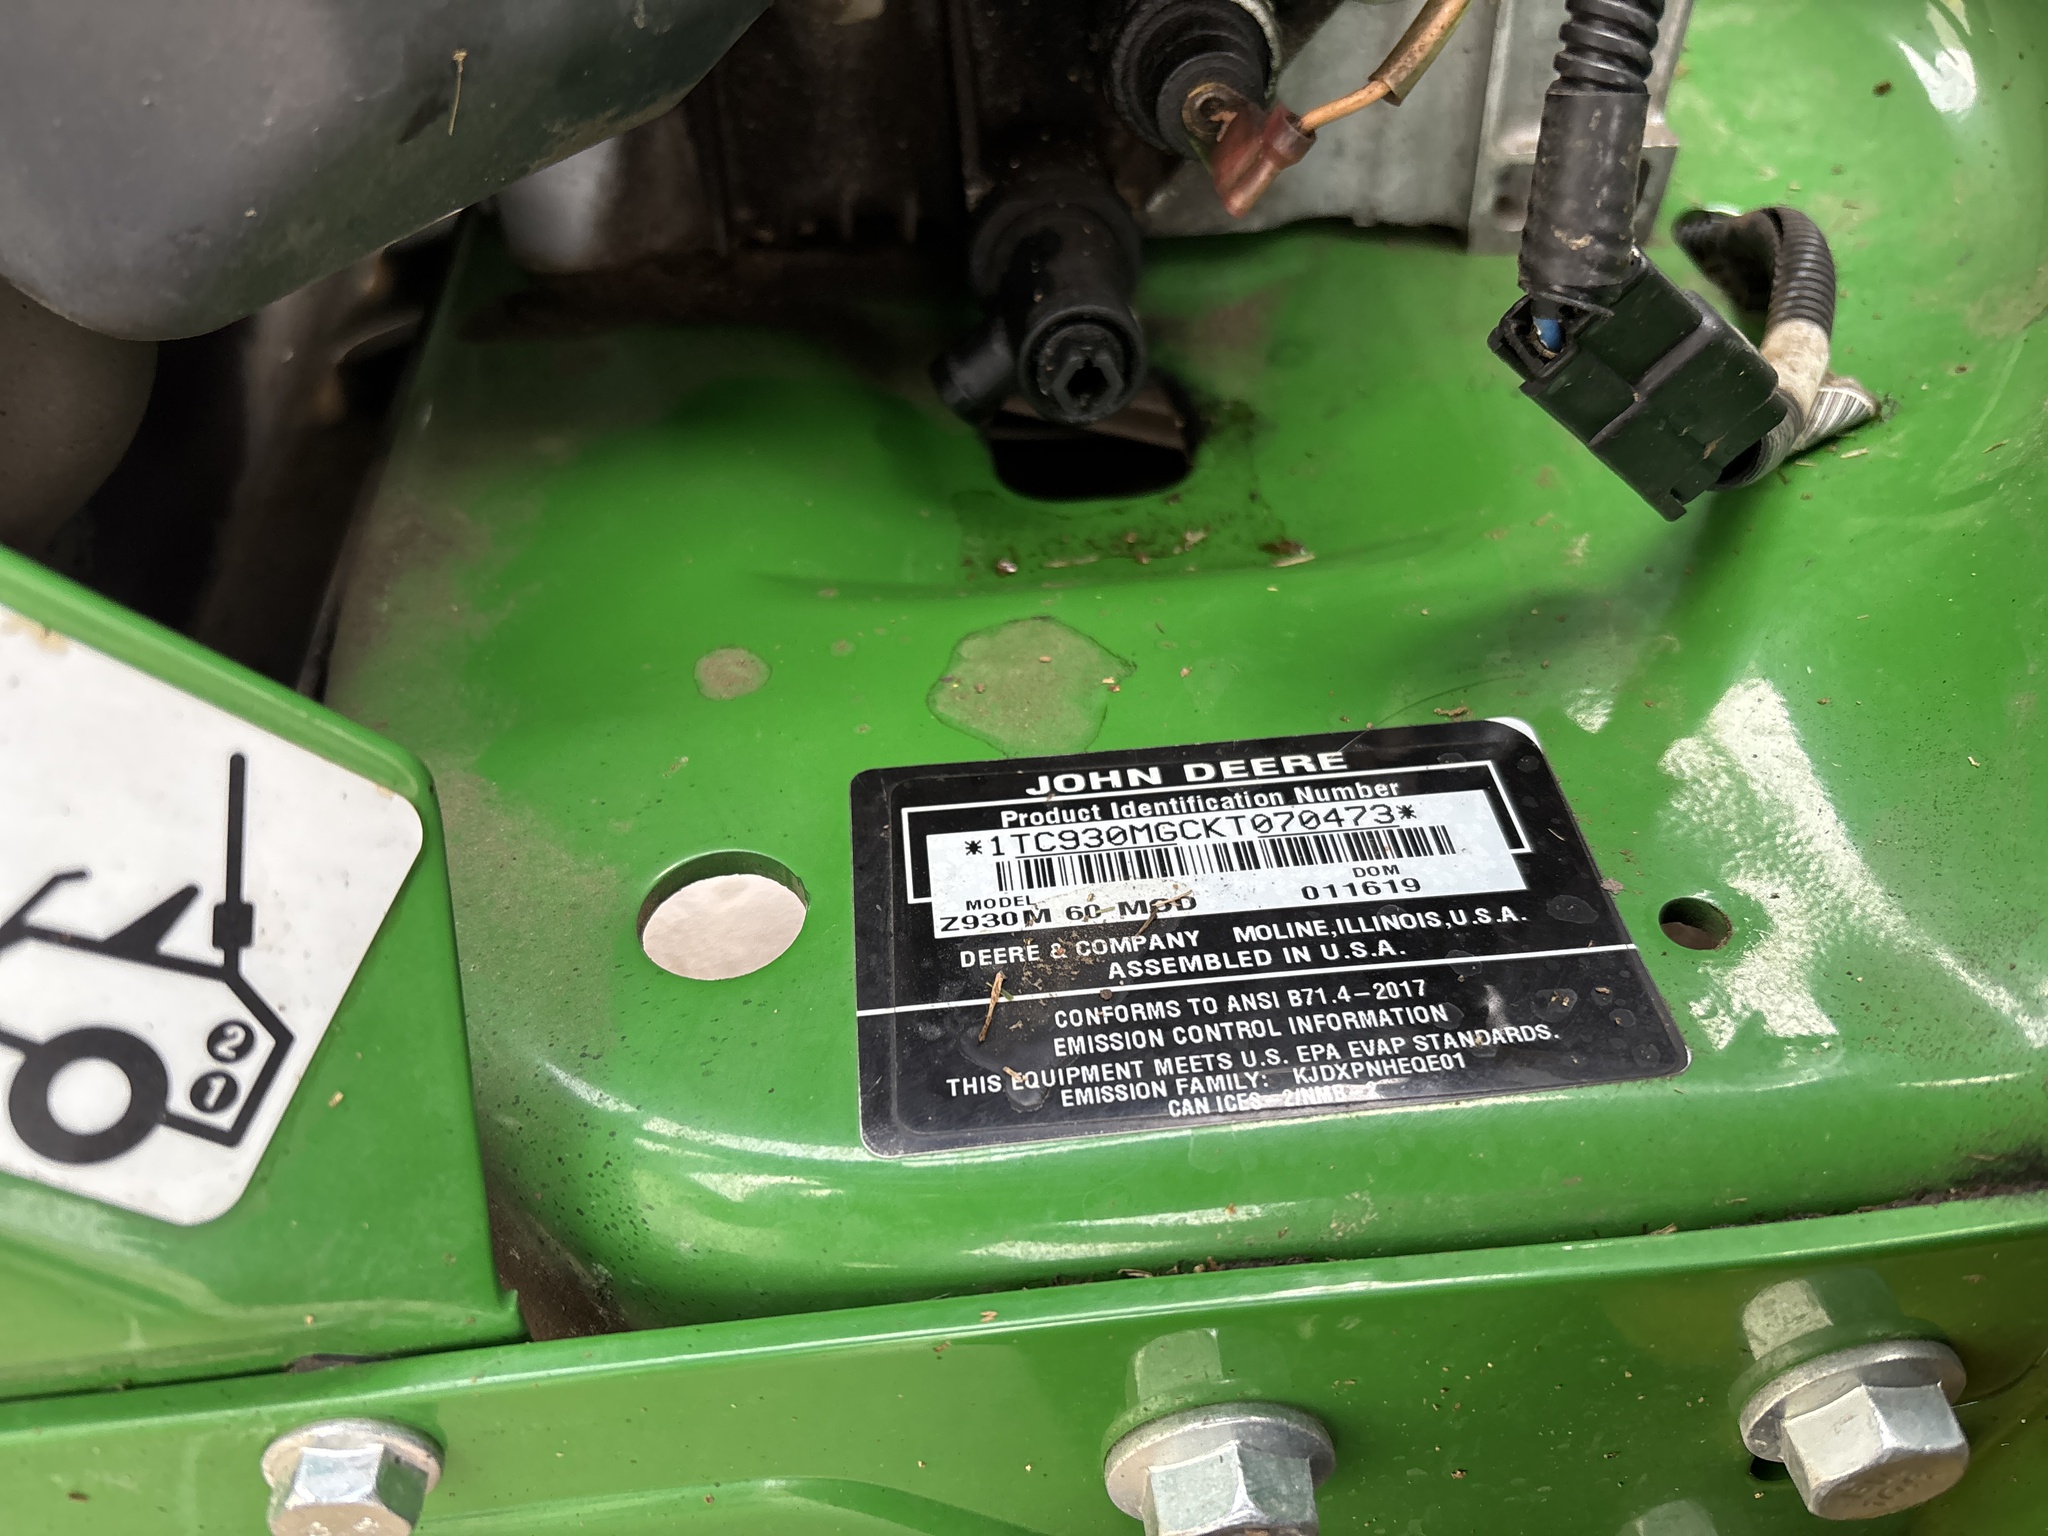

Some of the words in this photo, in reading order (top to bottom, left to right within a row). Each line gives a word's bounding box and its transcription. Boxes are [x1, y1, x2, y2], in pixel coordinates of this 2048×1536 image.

[1025, 766, 1163, 796] JOHN
[1183, 752, 1348, 783] DEERE
[1000, 806, 1102, 829] Product
[1111, 789, 1285, 820] Identification
[1293, 780, 1400, 804] Number
[1301, 877, 1422, 900] 011619
[1352, 864, 1401, 878] DOM
[939, 908, 1052, 932] Z930M
[1065, 903, 1101, 922] 60
[965, 895, 1034, 911] MODEL
[960, 944, 1041, 968] DEERE
[1050, 942, 1067, 959] &
[1075, 930, 1200, 957] COMPANY
[1108, 949, 1273, 980] ASSEMBLED
[1284, 948, 1312, 965] IN
[1319, 939, 1406, 961] U.S.A.
[1054, 1000, 1182, 1029] CONFORMS
[1187, 996, 1219, 1016] TO
[1227, 990, 1280, 1013] ANSI
[213, 1023, 246, 1060] 2
[1053, 1028, 1165, 1057] EMISSION
[1172, 1017, 1283, 1045] CONTROL
[1289, 1003, 1449, 1035] INFORMATION
[946, 1074, 1002, 1097] THIS
[1011, 1060, 1144, 1091] EQUIPMENT
[1154, 1052, 1233, 1077] MEETS
[1241, 1048, 1289, 1068] U.S.
[1296, 1043, 1341, 1063] EPA
[1349, 1036, 1406, 1059] EVAP
[1412, 1023, 1560, 1051] STANDARDS.
[203, 1075, 227, 1109] 1
[1060, 1080, 1168, 1107] EMISSION
[1176, 1071, 1269, 1096] FAMILY:
[1293, 1052, 1467, 1085] KJDXPNHEQE01
[1168, 1099, 1210, 1118] CAN
